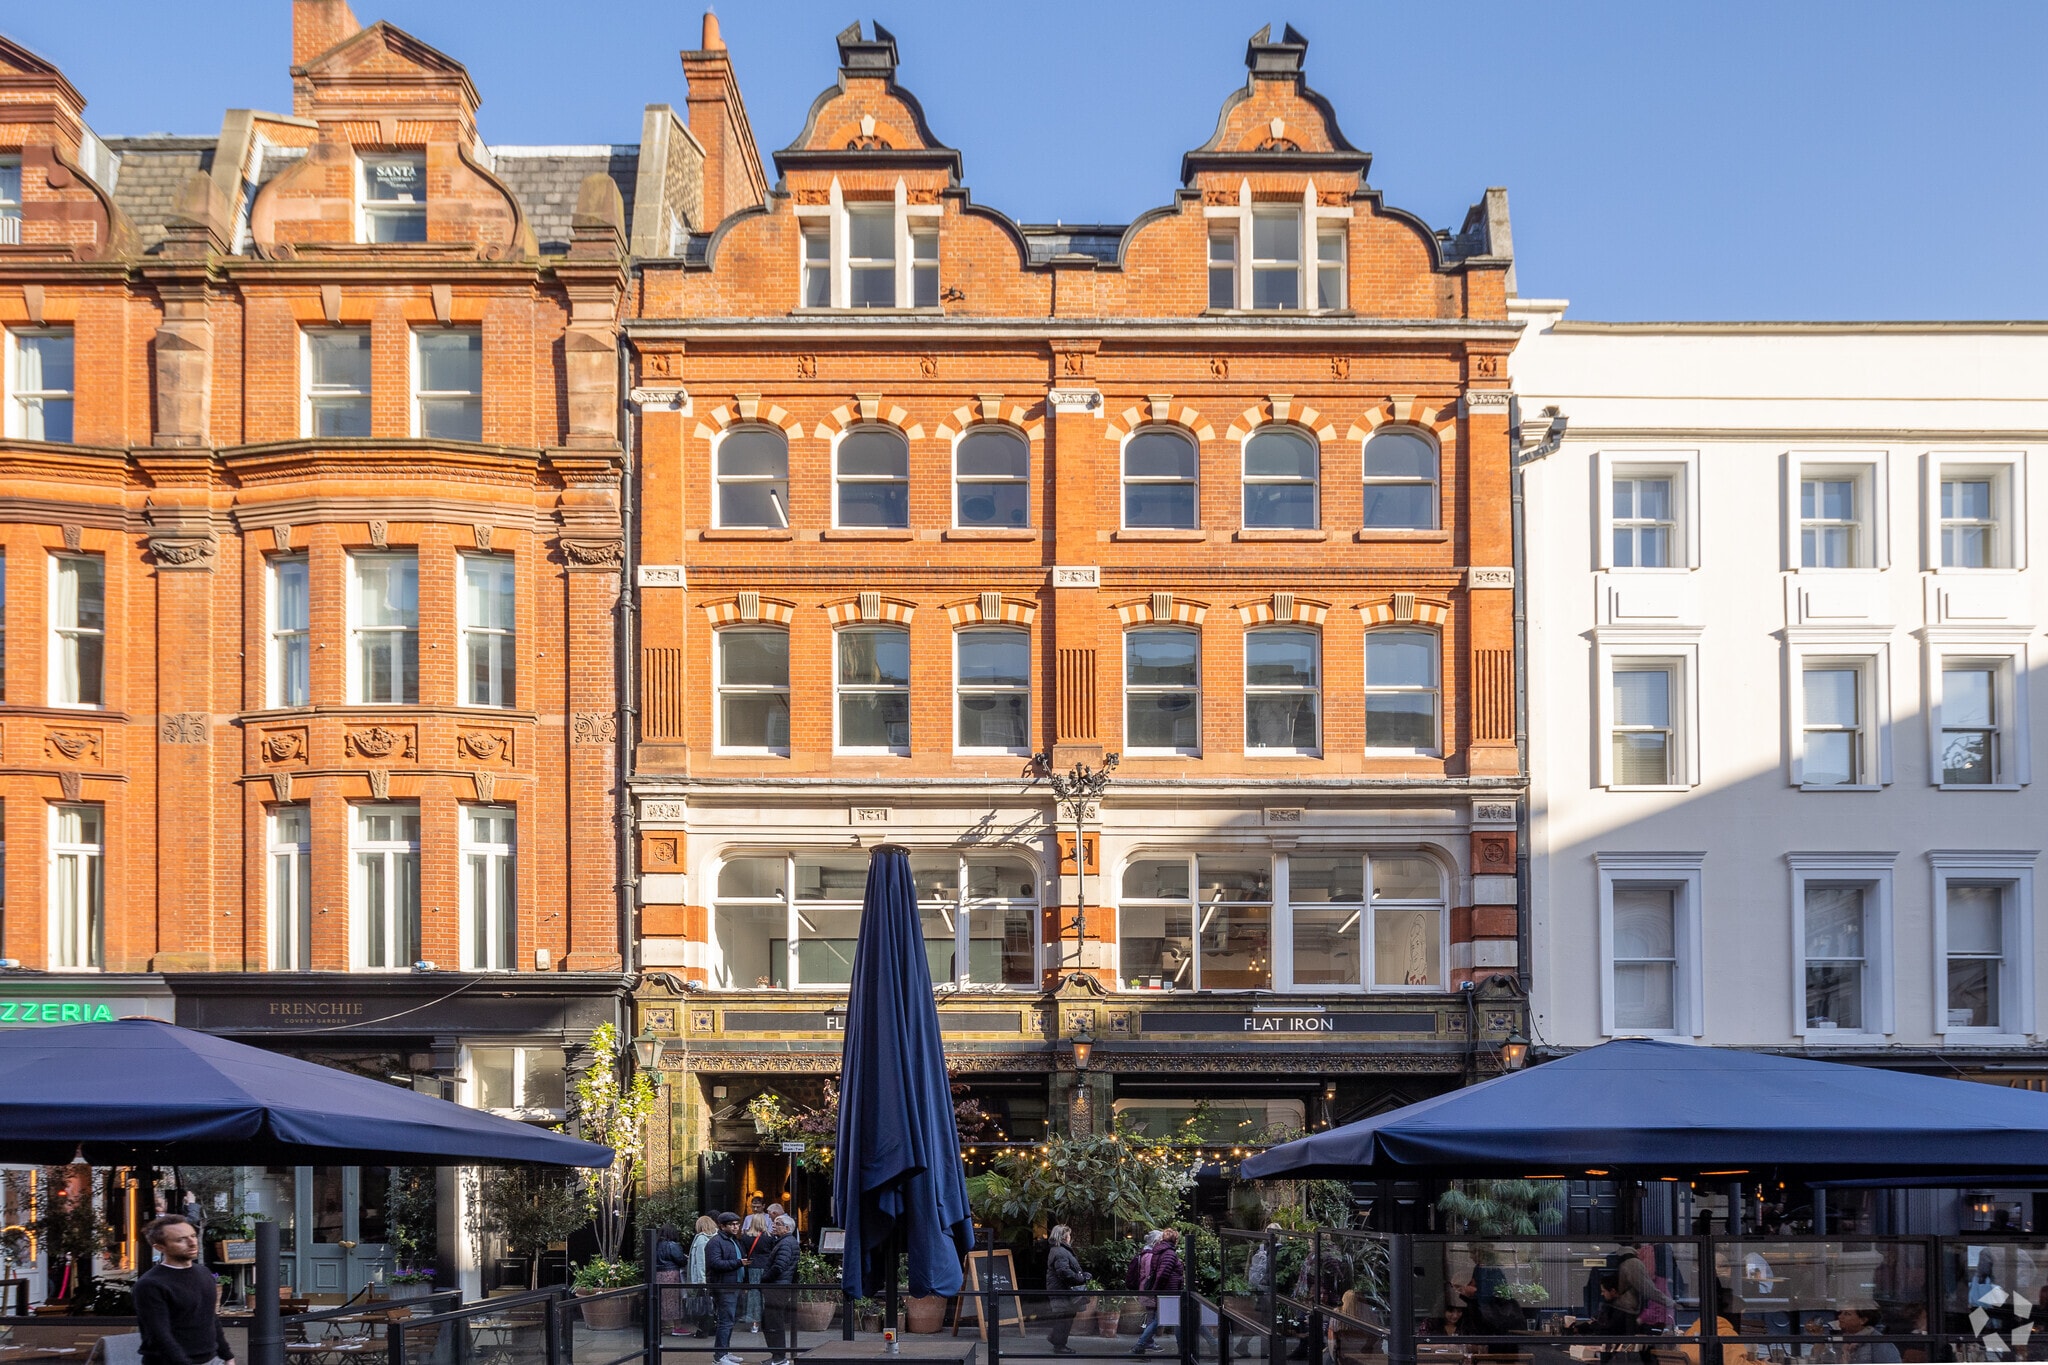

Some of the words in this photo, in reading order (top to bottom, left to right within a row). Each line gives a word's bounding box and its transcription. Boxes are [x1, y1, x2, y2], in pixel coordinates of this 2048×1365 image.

[376, 165, 417, 177] SANTA
[0, 1002, 113, 1022] ZZERIA
[269, 1003, 363, 1015] FRENCHIE
[1243, 1018, 1284, 1031] FLAT
[1289, 1018, 1333, 1031] IRON
[1590, 1198, 1598, 1206] 19
